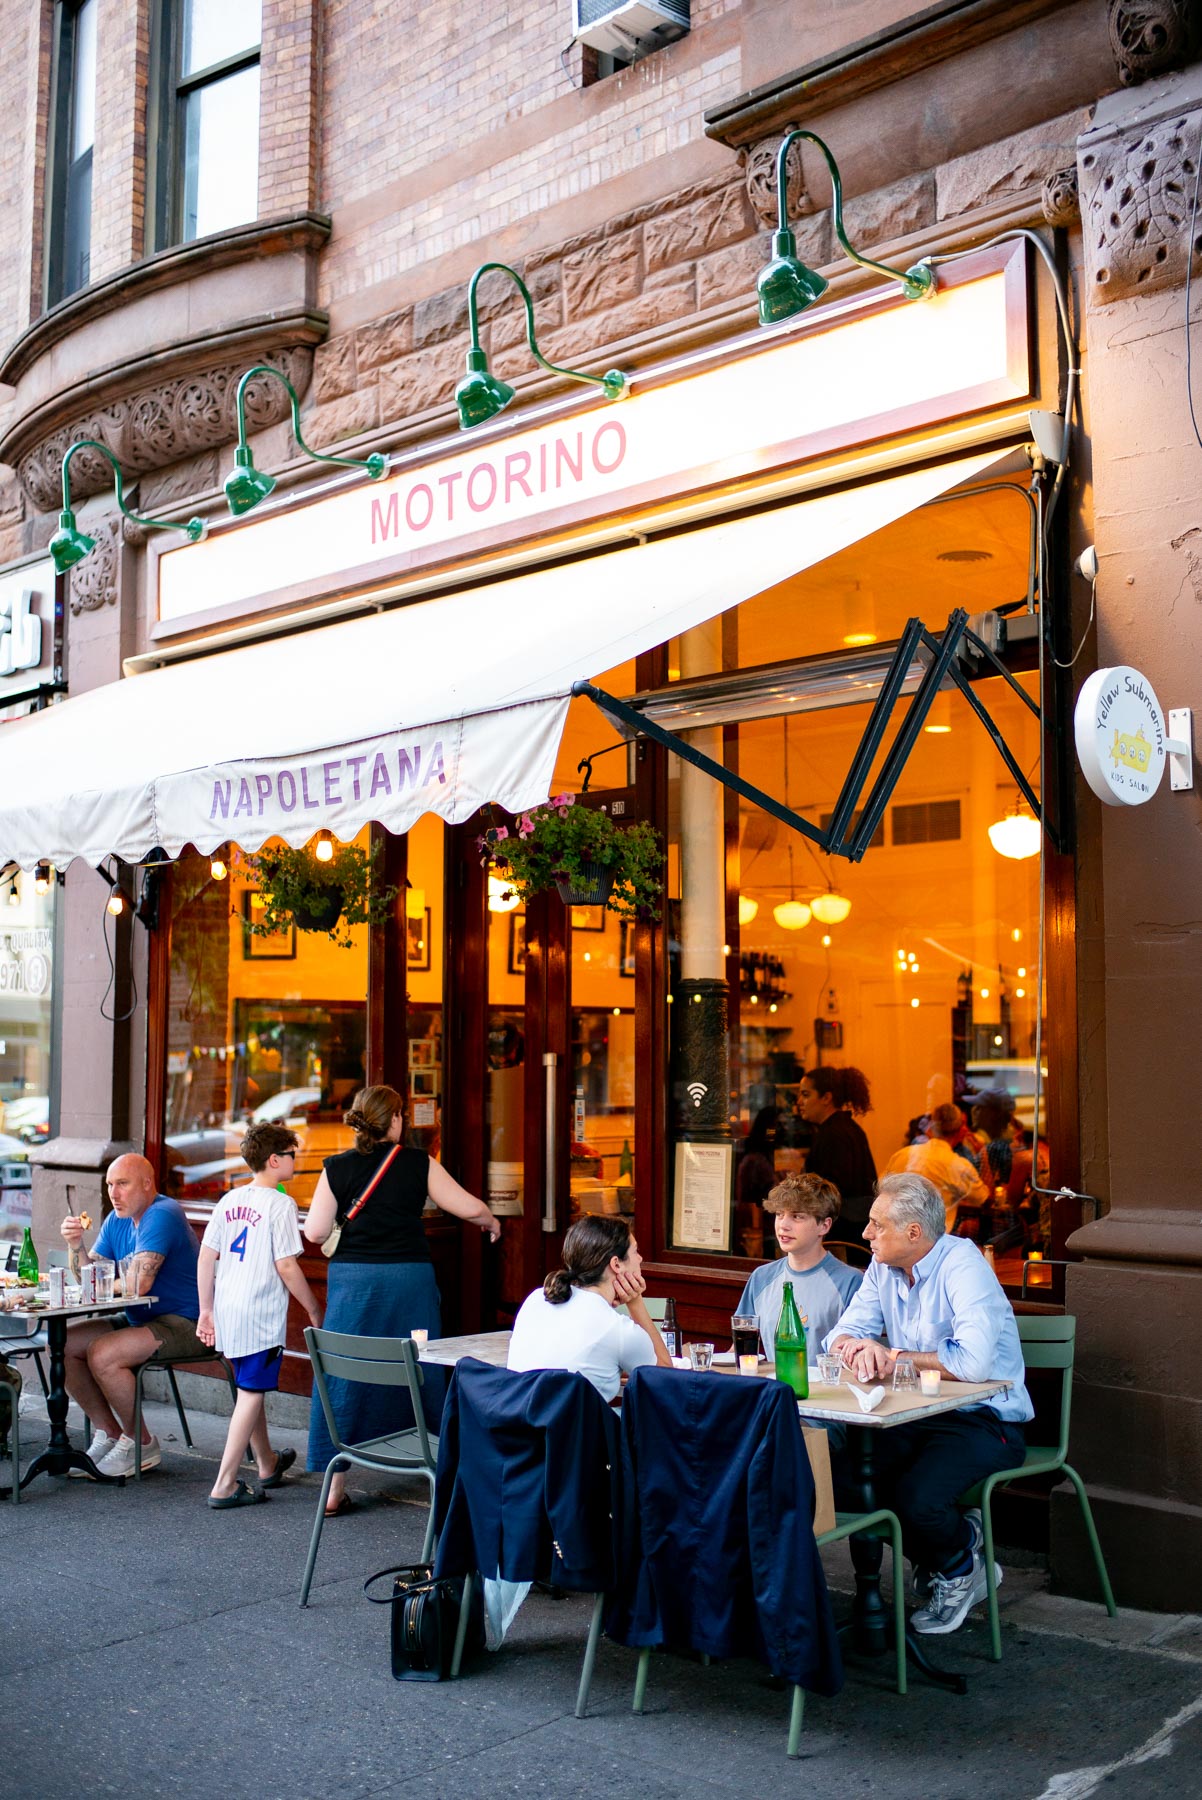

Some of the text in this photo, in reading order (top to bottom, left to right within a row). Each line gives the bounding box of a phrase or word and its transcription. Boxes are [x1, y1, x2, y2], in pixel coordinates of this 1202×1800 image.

[371, 420, 627, 544] MOTORINO
[1097, 676, 1163, 755] Yellow Submarine
[209, 741, 447, 819] NAPOLETANA
[1111, 771, 1150, 793] KIDS SALON
[612, 802, 624, 814] 510
[225, 1206, 262, 1227] ALVAREZ
[230, 1226, 248, 1262] 4
